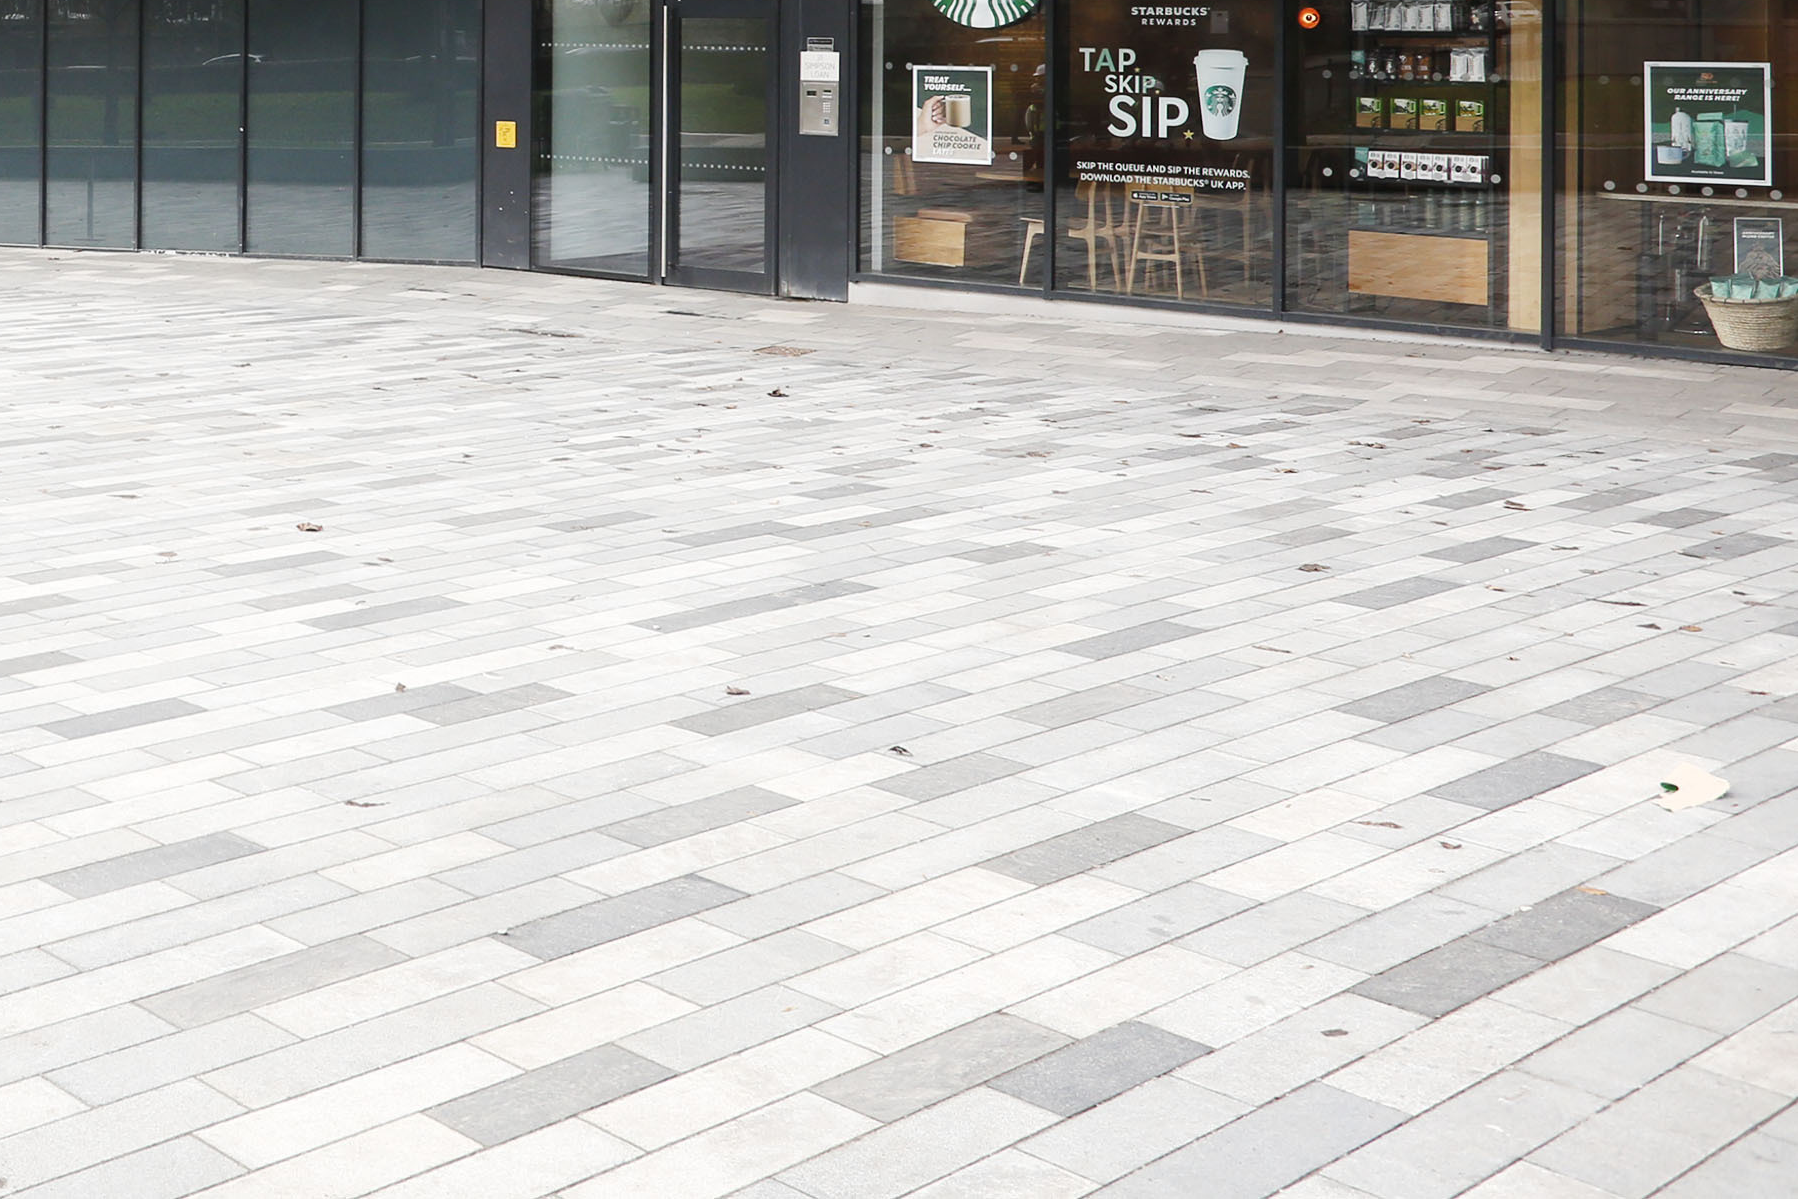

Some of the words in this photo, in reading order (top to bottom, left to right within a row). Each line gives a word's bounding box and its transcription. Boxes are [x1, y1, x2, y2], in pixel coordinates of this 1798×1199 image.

[1141, 18, 1197, 26] REWARDS
[1076, 161, 1096, 169] SKIP
[1097, 162, 1114, 171] THE
[1115, 163, 1145, 172] QUEUE
[1146, 164, 1166, 173] AND
[1167, 165, 1182, 174] SIP
[1183, 166, 1201, 175] THE
[1202, 167, 1250, 179] REWARDS.
[1080, 173, 1133, 183] DOWNLOAD
[1134, 175, 1152, 184] THE
[1210, 180, 1224, 189] UK
[1225, 181, 1246, 191] APP.
